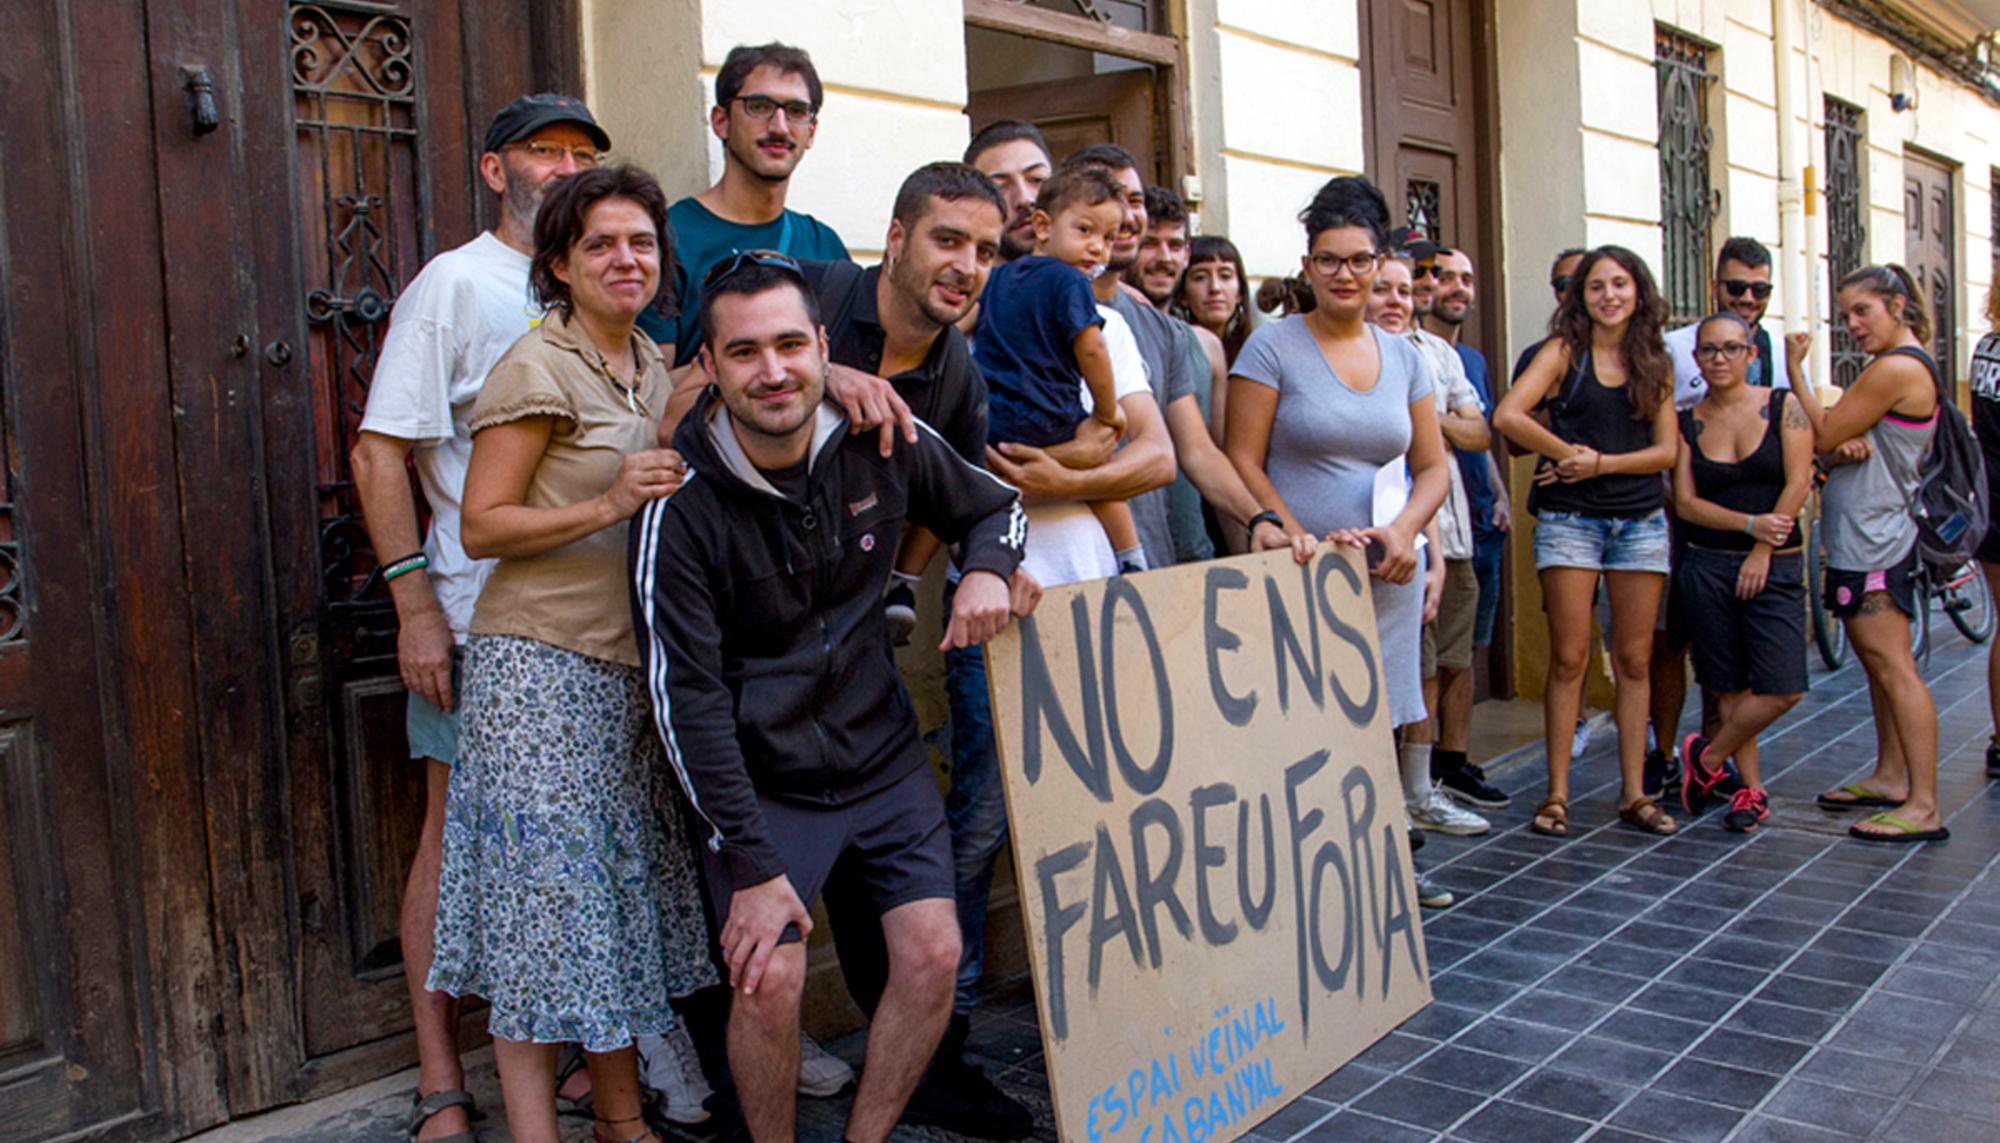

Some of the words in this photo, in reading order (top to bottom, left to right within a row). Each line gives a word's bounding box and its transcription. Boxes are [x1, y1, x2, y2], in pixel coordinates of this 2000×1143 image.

[1019, 577, 1174, 802] NO
[1204, 553, 1378, 727] ENS
[1035, 782, 1277, 1043] FAREU
[1284, 749, 1423, 1048] FORA
[1087, 1026, 1181, 1143] ESPAI
[1190, 996, 1286, 1078] VEÏNAL
